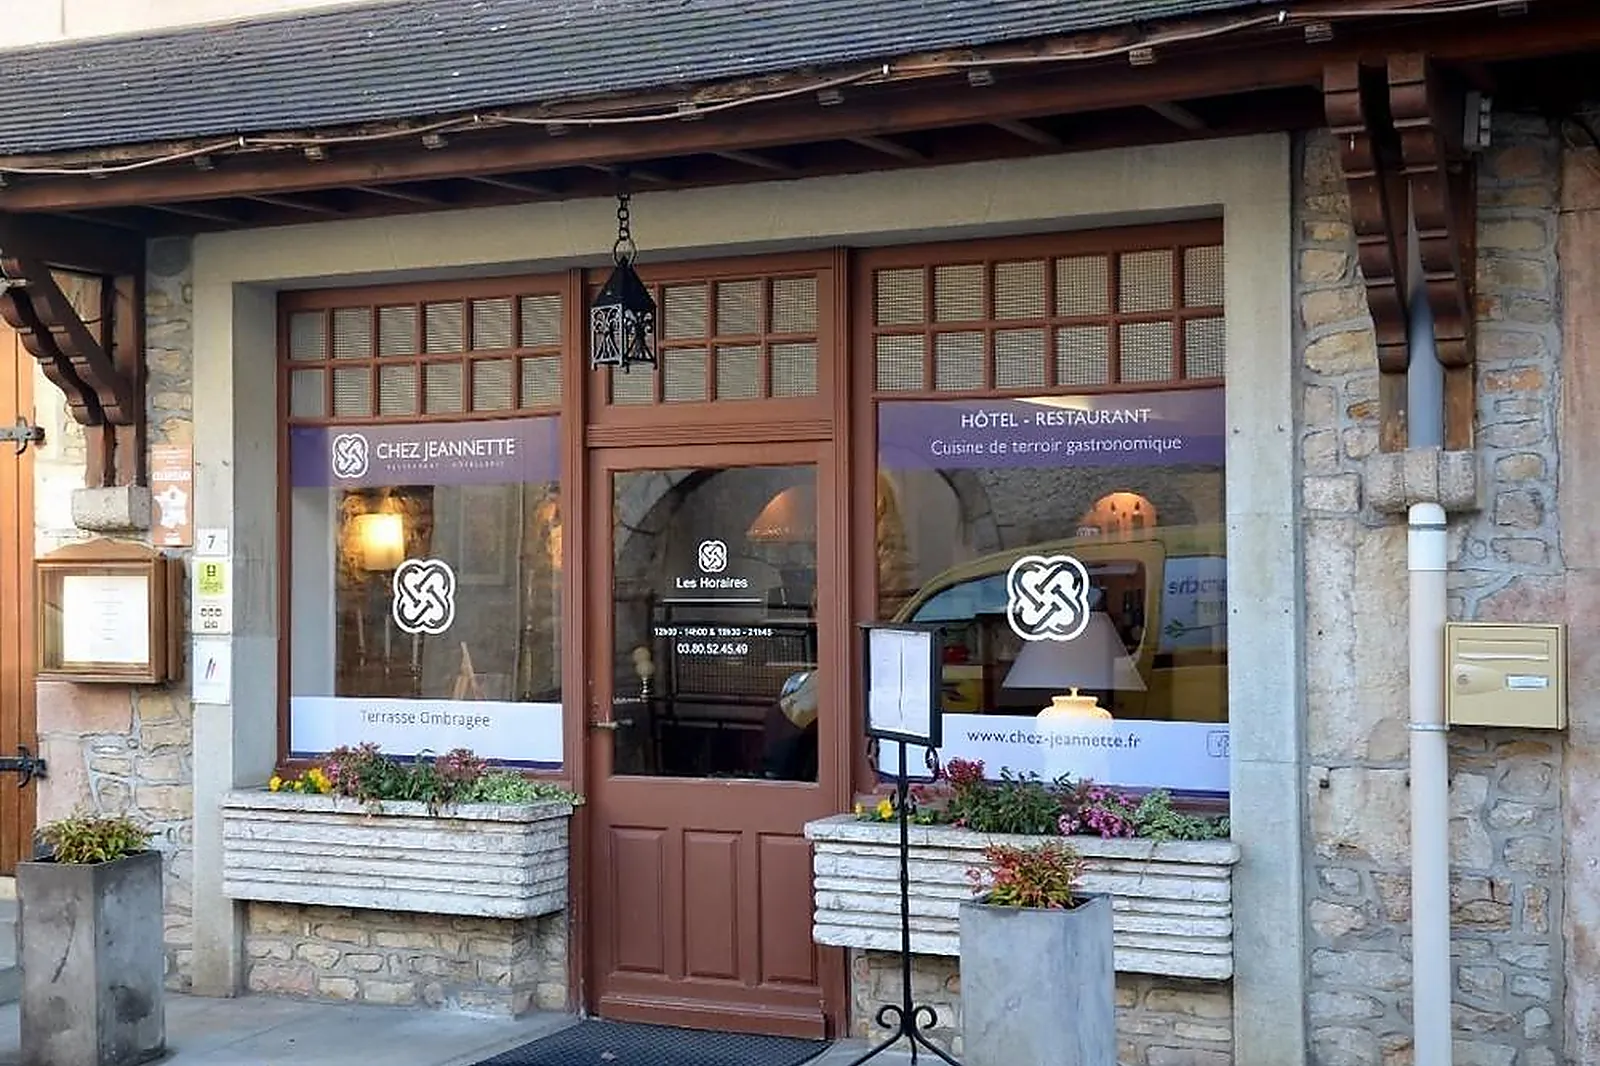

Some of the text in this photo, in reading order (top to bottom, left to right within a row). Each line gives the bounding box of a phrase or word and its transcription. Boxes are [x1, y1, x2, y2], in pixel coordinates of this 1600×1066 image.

[961, 408, 1018, 428] HÔTEL
[1036, 408, 1152, 426] RESTAURANT
[377, 438, 515, 461] CHEZ JEANNETTE
[931, 436, 1182, 456] Cuisine de terroir gastronomique
[207, 535, 217, 550] 7
[676, 577, 749, 589] Les Horaires
[360, 709, 416, 725] Terrasse
[966, 729, 1141, 750] www.chez-jeannette.fr
